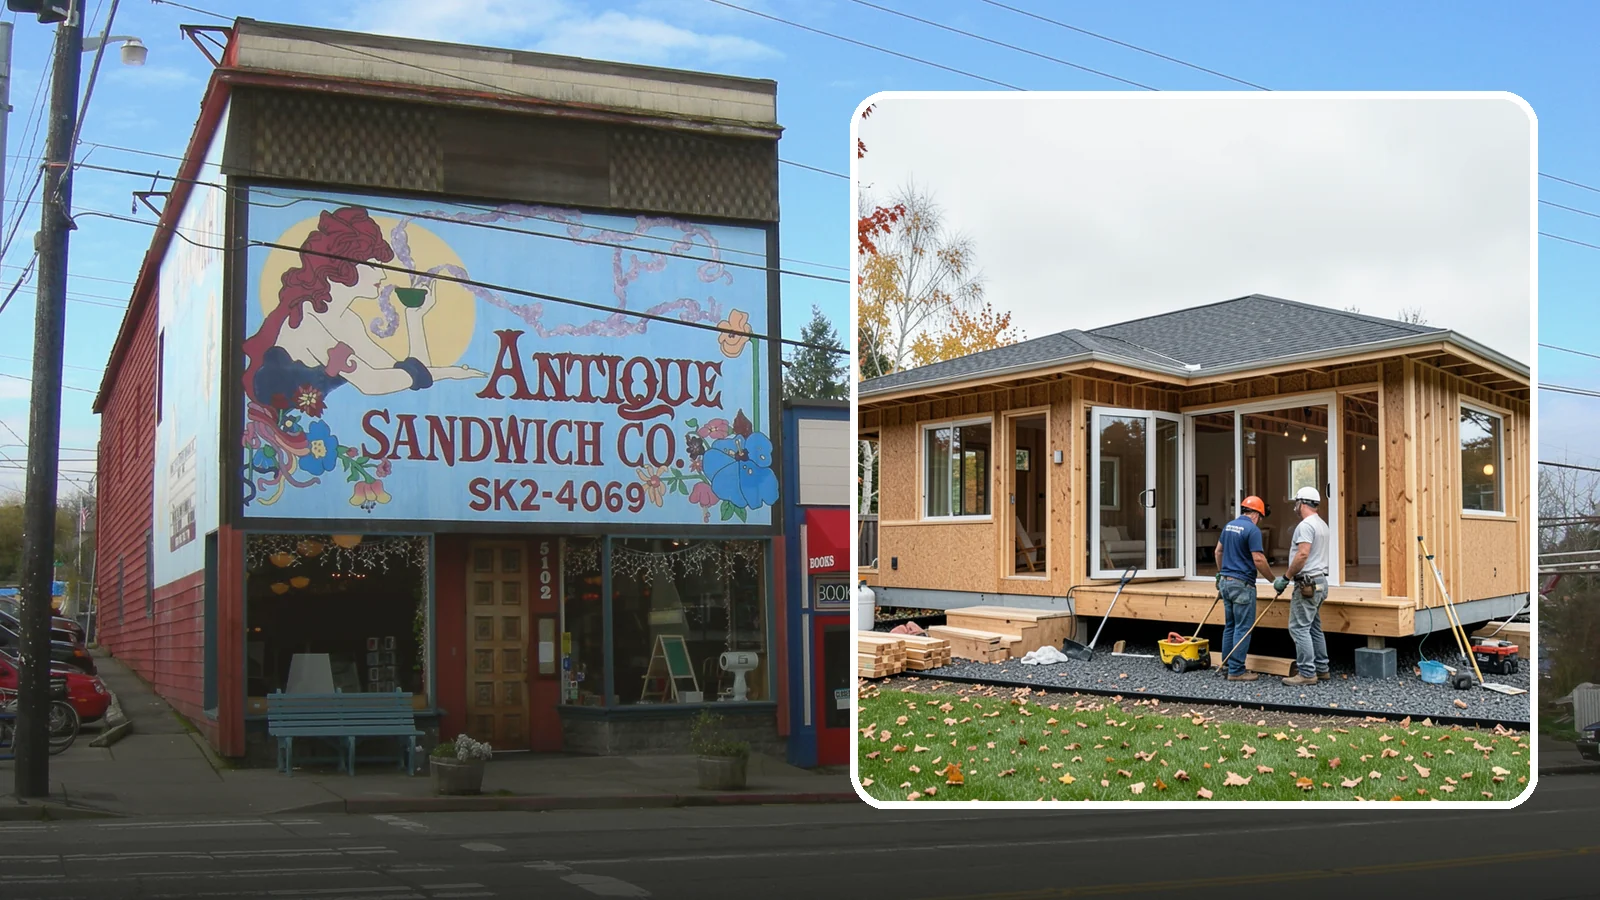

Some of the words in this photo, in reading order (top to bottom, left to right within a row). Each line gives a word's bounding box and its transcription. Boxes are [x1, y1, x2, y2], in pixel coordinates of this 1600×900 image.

[476, 329, 724, 420] ANTIQUE
[361, 408, 604, 467] SANDWICH
[617, 422, 686, 468] CO.
[468, 477, 646, 513] SK2-4069
[539, 542, 551, 600] 5102
[809, 555, 834, 568] BOOKS
